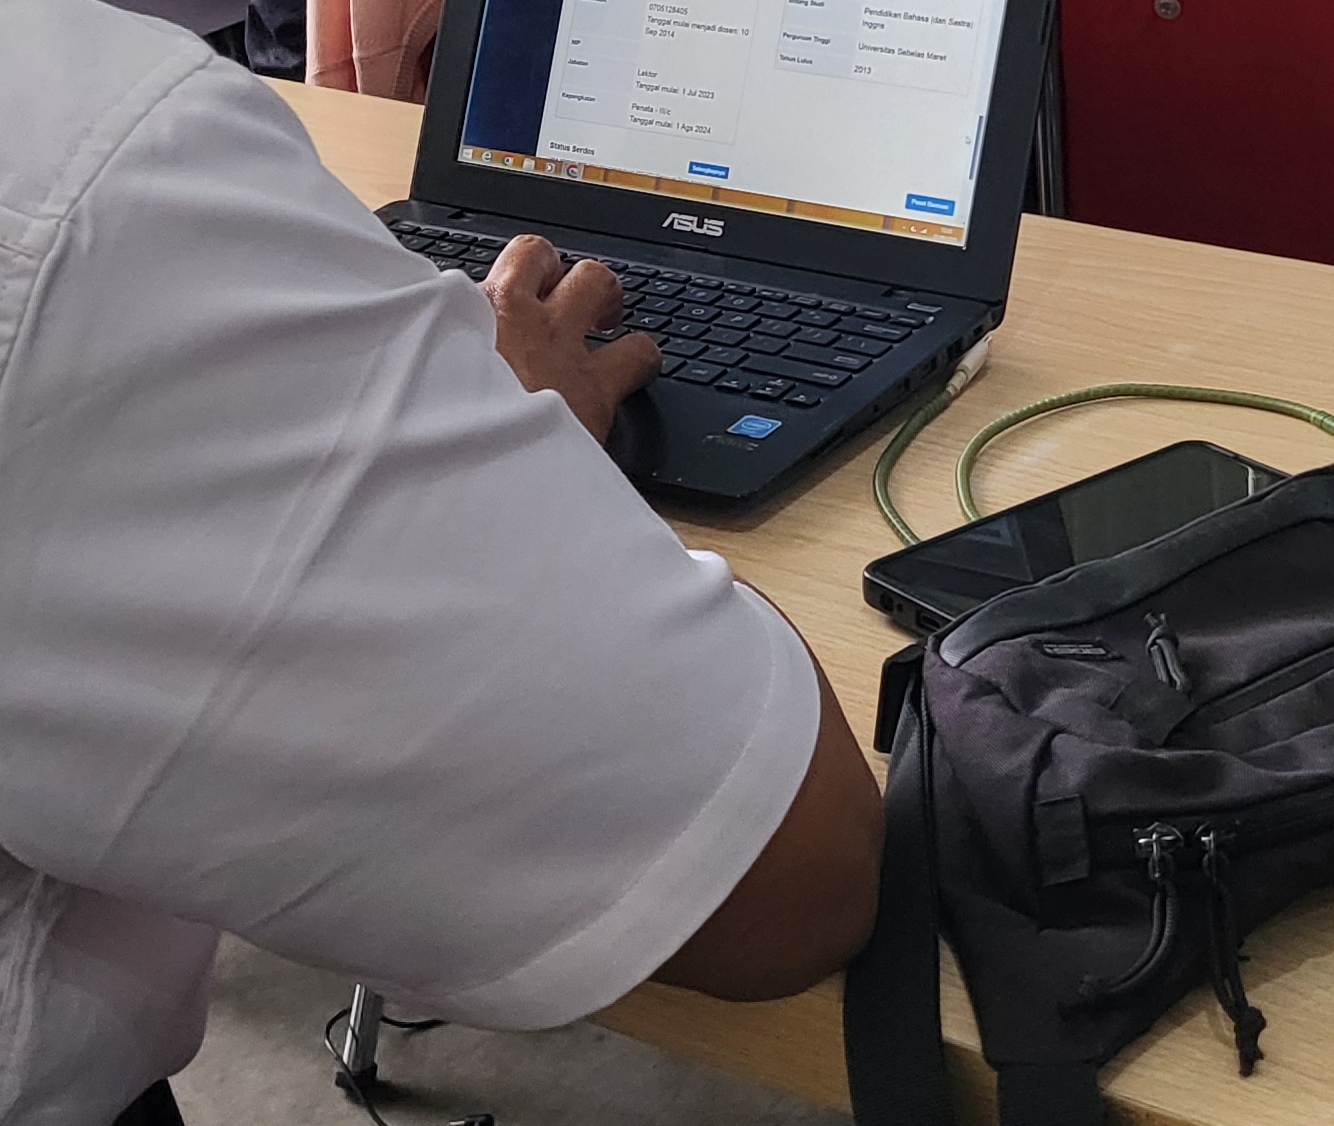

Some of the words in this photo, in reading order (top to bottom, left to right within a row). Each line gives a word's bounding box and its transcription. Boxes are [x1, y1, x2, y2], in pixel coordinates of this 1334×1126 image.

[809, 0, 825, 7] Studi
[864, 7, 901, 20] Pendidikan
[903, 12, 929, 23] Bahasa
[930, 15, 947, 26] (dan
[948, 17, 973, 29] Sastra)
[647, 16, 671, 27] Tanggal
[672, 19, 690, 28] mulai
[691, 21, 716, 32] menjadi
[717, 25, 738, 34] dosen:
[740, 28, 749, 36] 10
[862, 20, 885, 31] Inggris
[645, 28, 657, 38] Sep
[658, 29, 675, 38] 2014
[782, 32, 812, 42] Perguruan
[813, 35, 831, 45] Tinggi
[858, 42, 895, 55] Universitas
[897, 47, 925, 59] Sebelas
[926, 51, 947, 62] Maret
[779, 54, 796, 63] Tahun
[797, 56, 813, 65] Lulus
[637, 69, 658, 78] Lektor
[854, 65, 872, 75] 2013
[636, 81, 660, 92] Tanggal
[661, 84, 679, 94] mulai:
[687, 88, 697, 97] Jul
[698, 90, 715, 99] 2023
[631, 103, 654, 113] Penata
[629, 115, 654, 126] Tanggal
[655, 119, 673, 129] mulai:
[681, 123, 693, 134] Ags
[694, 125, 711, 134] 2024
[549, 141, 570, 153] Status
[571, 144, 595, 156] Serdos
[662, 212, 725, 237] ASUS
